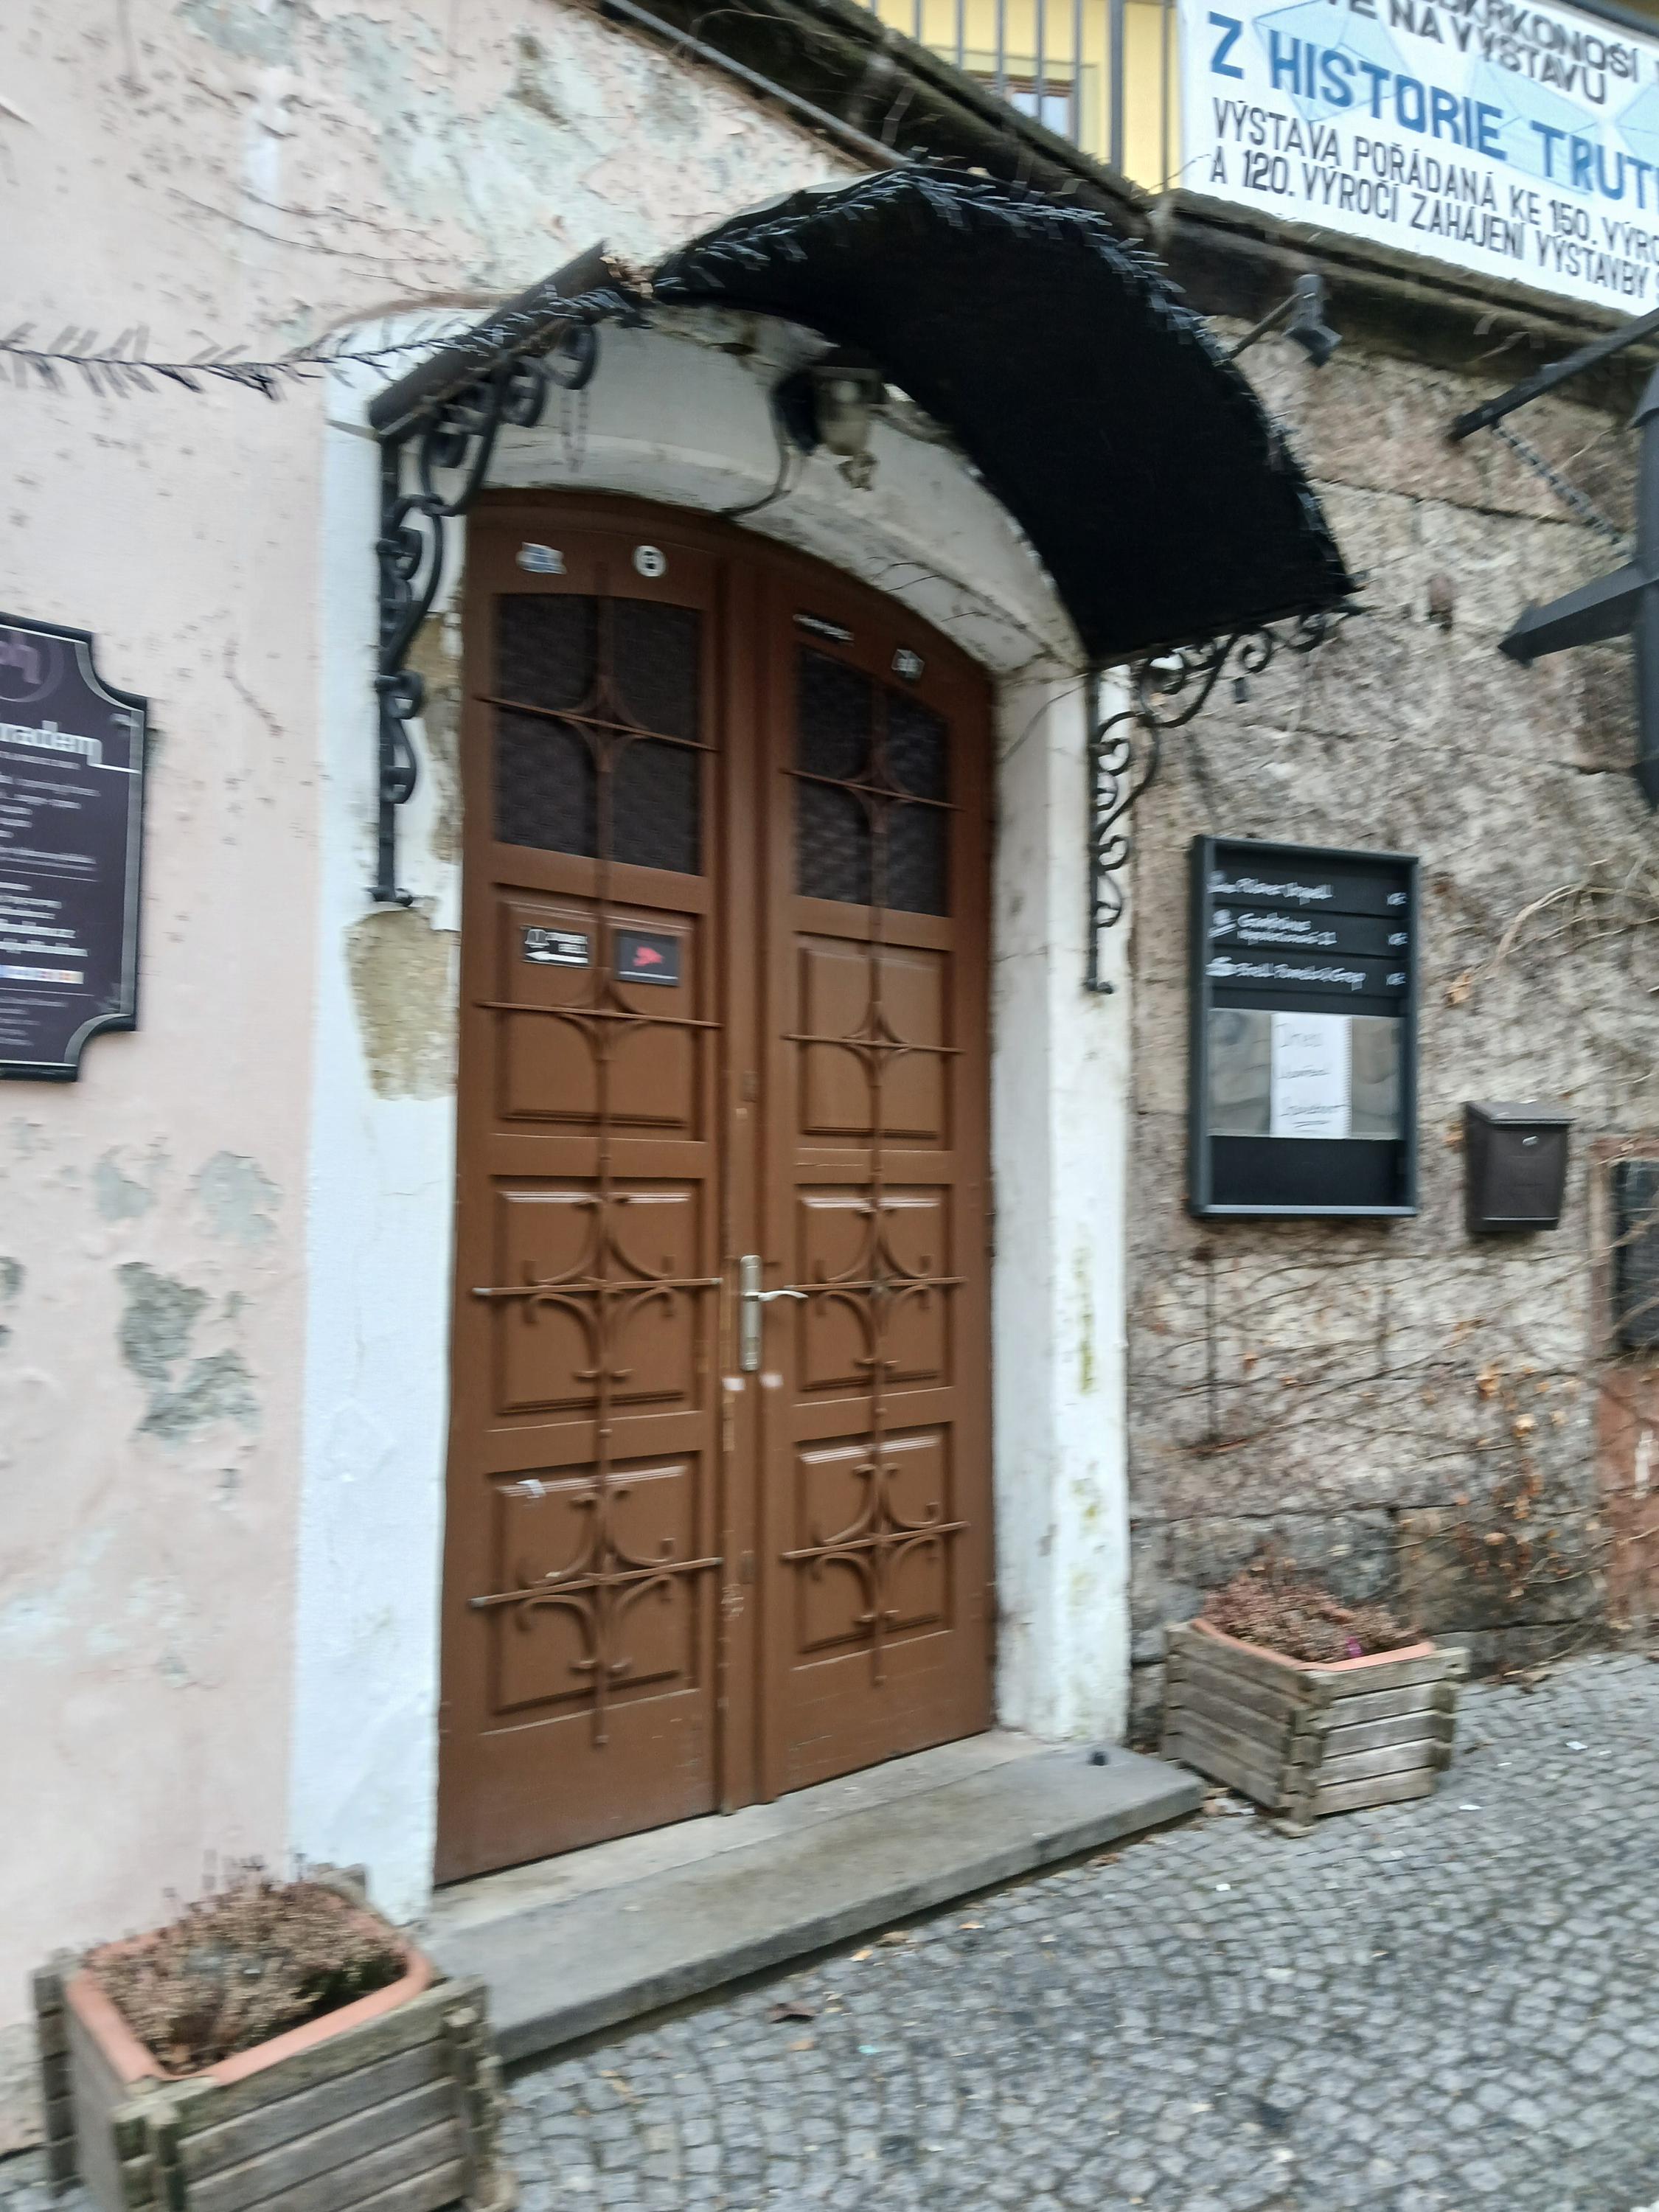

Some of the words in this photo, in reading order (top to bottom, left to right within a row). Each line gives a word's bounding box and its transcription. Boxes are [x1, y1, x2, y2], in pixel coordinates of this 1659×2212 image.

[1389, 0, 1445, 44] NA
[1425, 0, 1638, 83] KRKONOŠÍ
[1208, 11, 1244, 80] Z
[1269, 29, 1507, 161] HISTORIE
[1530, 119, 1659, 214] TRUT
[1212, 97, 1341, 167] VÝSTAVA
[1354, 136, 1498, 212] POŘÁDANÁ
[1509, 184, 1540, 225] KE
[1548, 199, 1598, 245] 150.
[1210, 146, 1228, 184] A
[1243, 150, 1294, 197] 120.
[1301, 162, 1399, 223] VÝROČÍ
[1410, 192, 1526, 260] ZAHÁJENÍ
[1534, 230, 1649, 299] VÝSTAVBY
